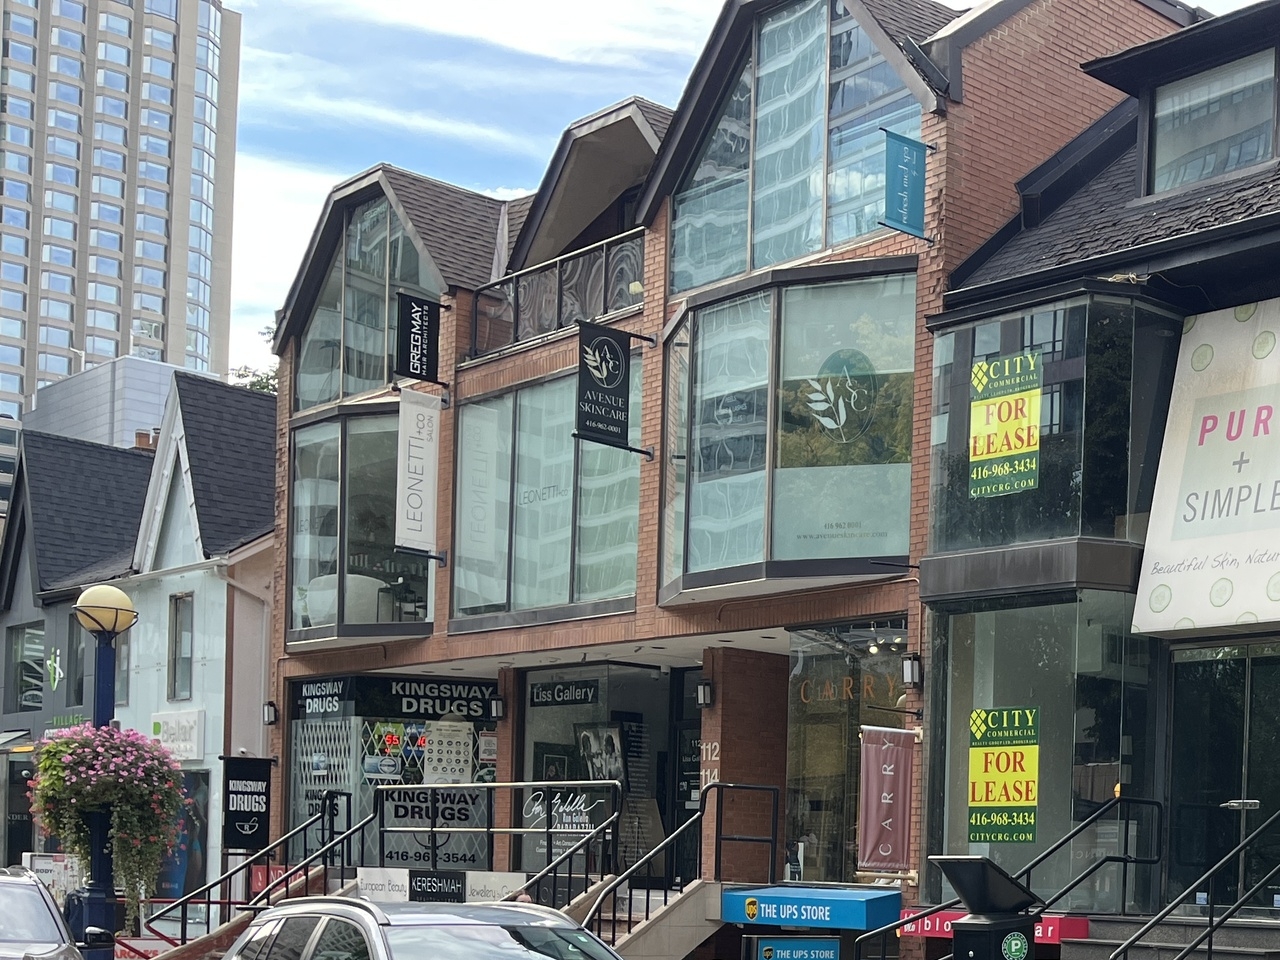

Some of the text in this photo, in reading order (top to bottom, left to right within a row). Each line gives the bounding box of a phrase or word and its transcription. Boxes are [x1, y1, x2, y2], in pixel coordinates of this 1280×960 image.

[989, 352, 1038, 379] CITY
[988, 373, 1038, 389] COMMERCIAL
[584, 390, 625, 409] AVENUE
[579, 401, 628, 422] SKINCARE
[984, 397, 1027, 426] FOR
[426, 415, 434, 443] SALON
[585, 419, 622, 434] 416-962-0001
[972, 424, 1038, 457] LEASE
[970, 457, 1037, 480] 416-968-3434
[970, 478, 1035, 496] CITYCRG.COM
[1150, 555, 1206, 577] Beautiful
[1212, 551, 1240, 570] Skin,
[302, 681, 344, 697] KINGSWAY
[391, 682, 494, 698] KINGSWAY
[533, 685, 594, 702] Liss Gallery
[800, 672, 898, 704] CARRY
[305, 696, 339, 713] DRUGS
[401, 698, 484, 716] DRUGS
[52, 714, 84, 726] VILLAGE
[987, 709, 1036, 728] CITY
[987, 729, 1036, 738] COMMERCIAL
[701, 742, 720, 760] 112
[983, 751, 1026, 773] FOR
[229, 780, 267, 793] KINGSWAY
[970, 780, 1036, 803] LEASE
[229, 794, 267, 812] DRUGS
[385, 790, 480, 806] KINGSWAY
[878, 738, 895, 856] CARRY
[394, 804, 470, 822] DRUGS
[969, 811, 1035, 826] 416-968-3434
[970, 832, 1033, 841] CITYCRG.COM
[385, 851, 477, 864] 416-96-3544
[359, 879, 407, 896] European Beauty
[411, 877, 462, 894] KERESHMAH
[468, 885, 496, 898] Jewellery
[760, 903, 777, 919] THE
[779, 904, 798, 920] UPS
[800, 905, 831, 921] STORE
[776, 949, 792, 959] THE
[792, 949, 809, 959] UPS
[810, 949, 835, 959] STORE
